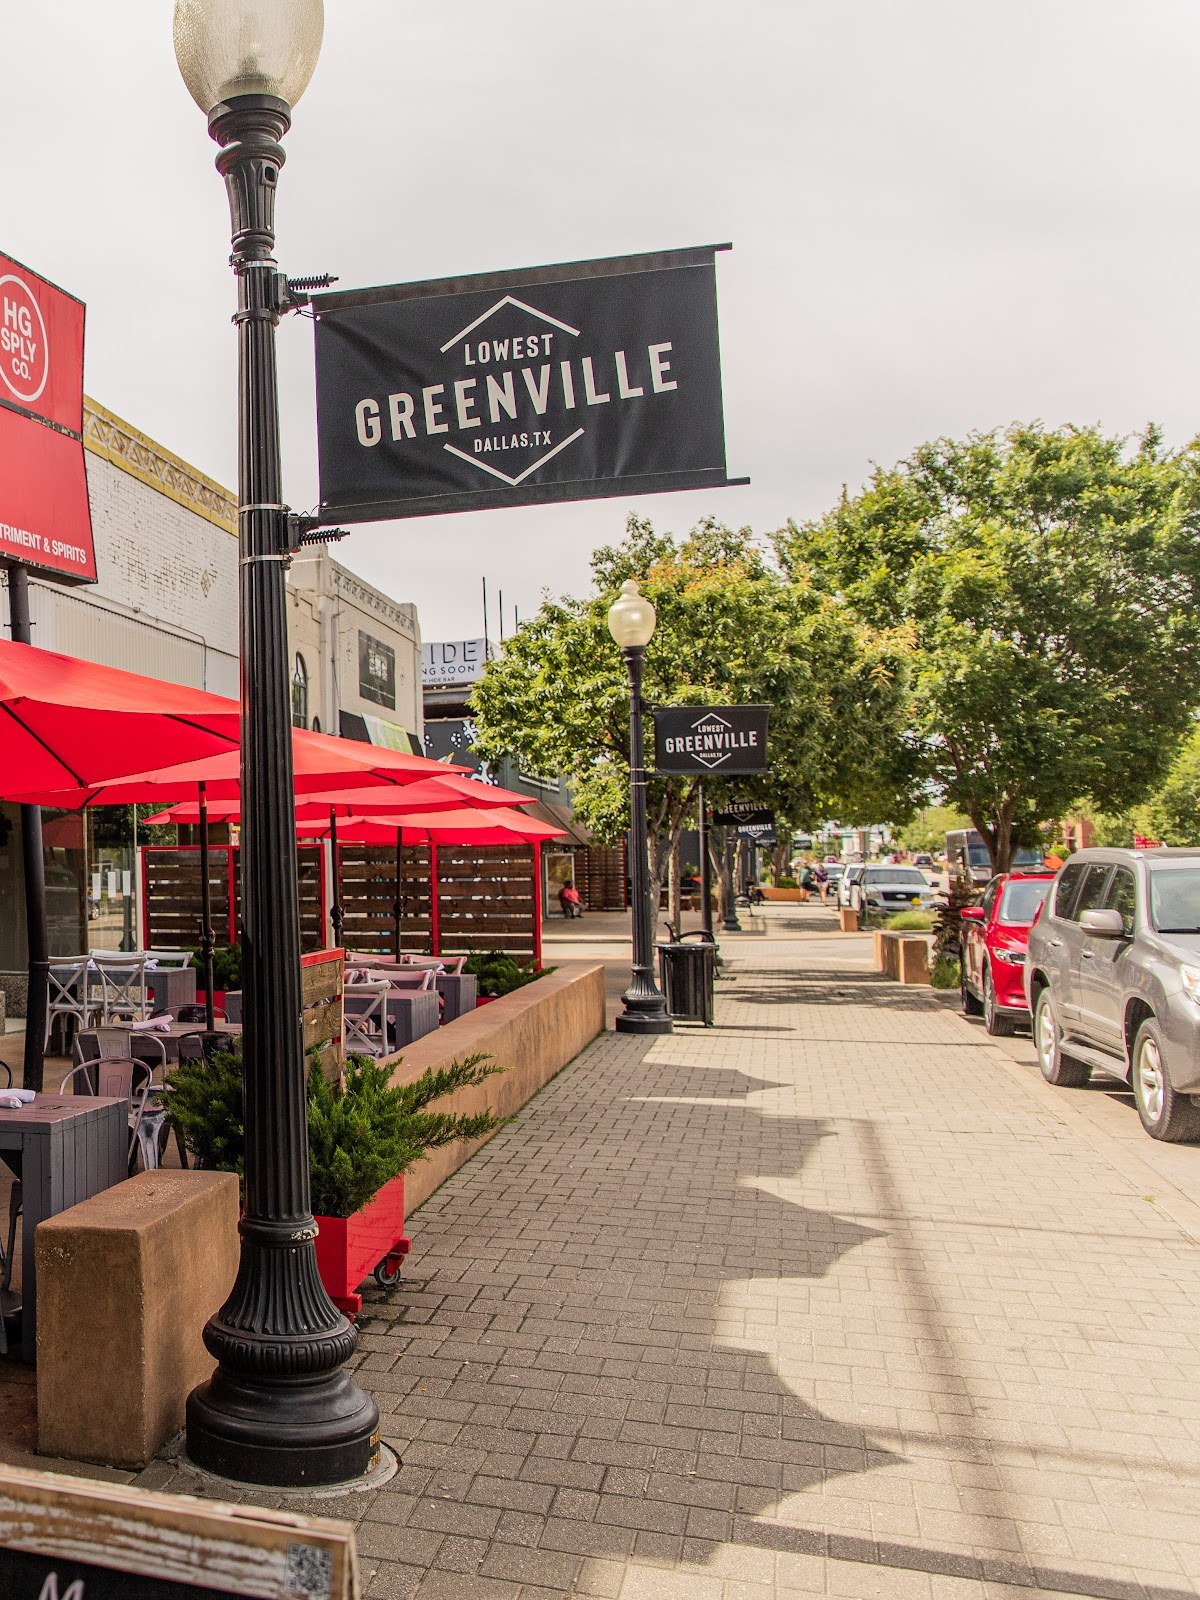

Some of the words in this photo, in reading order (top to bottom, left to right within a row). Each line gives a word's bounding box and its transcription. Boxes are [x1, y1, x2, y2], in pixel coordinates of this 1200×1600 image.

[3, 296, 32, 339] HG
[1, 327, 36, 364] SPLY
[464, 333, 553, 366] LOWEST
[11, 356, 31, 381] CO.
[355, 342, 678, 447] GREENVILLE
[474, 430, 551, 453] DALLAS,TX
[43, 537, 51, 552] &
[52, 540, 86, 564] SPIRITS
[421, 641, 477, 664] IDE
[440, 665, 475, 675] SOON
[698, 725, 724, 733] LOWEST
[665, 731, 757, 753] GREENVILLE
